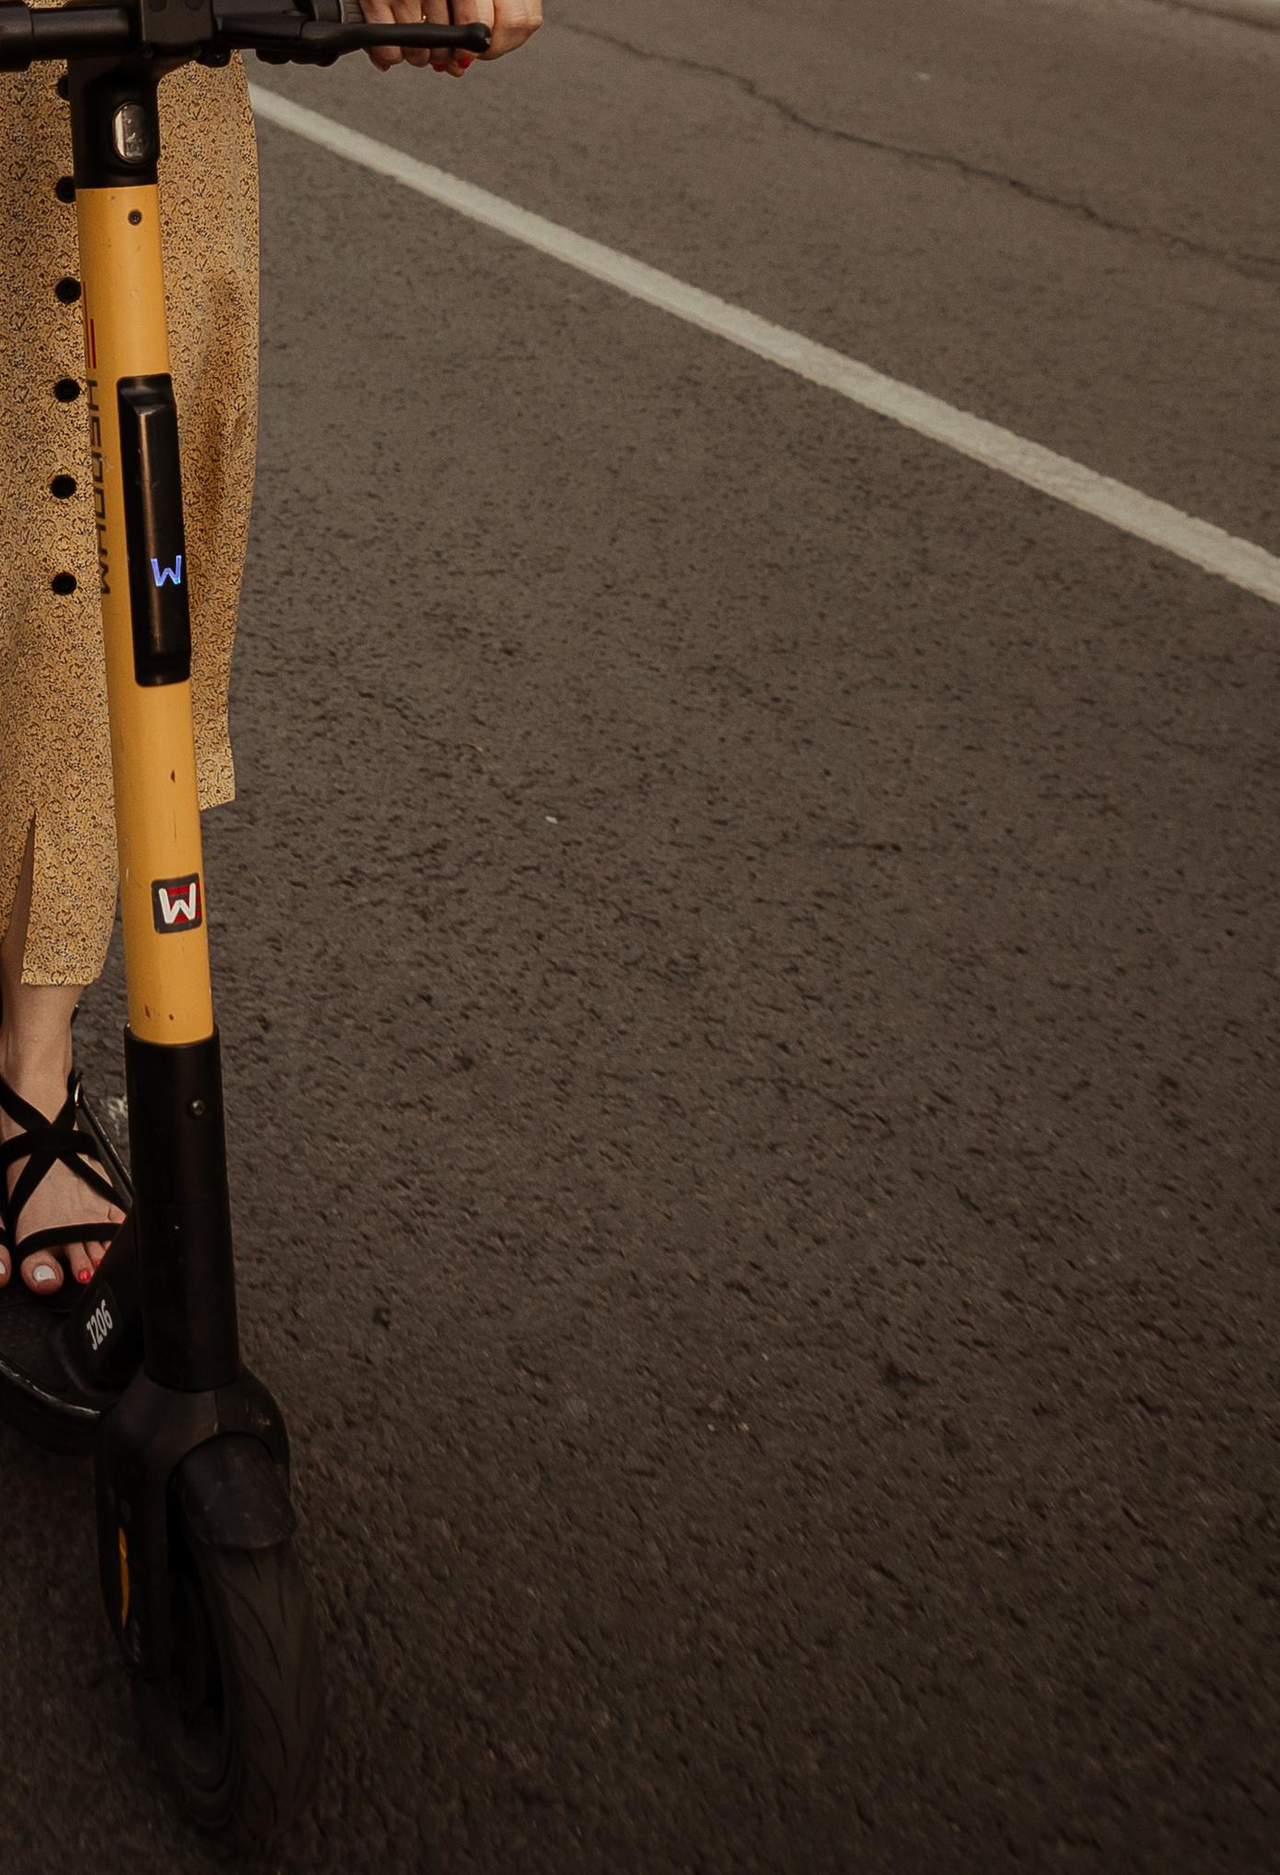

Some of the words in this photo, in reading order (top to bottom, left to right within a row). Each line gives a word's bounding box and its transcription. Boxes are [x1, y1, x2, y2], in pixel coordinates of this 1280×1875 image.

[150, 554, 182, 587] W
[158, 882, 197, 924] W
[86, 1299, 114, 1351] J206
